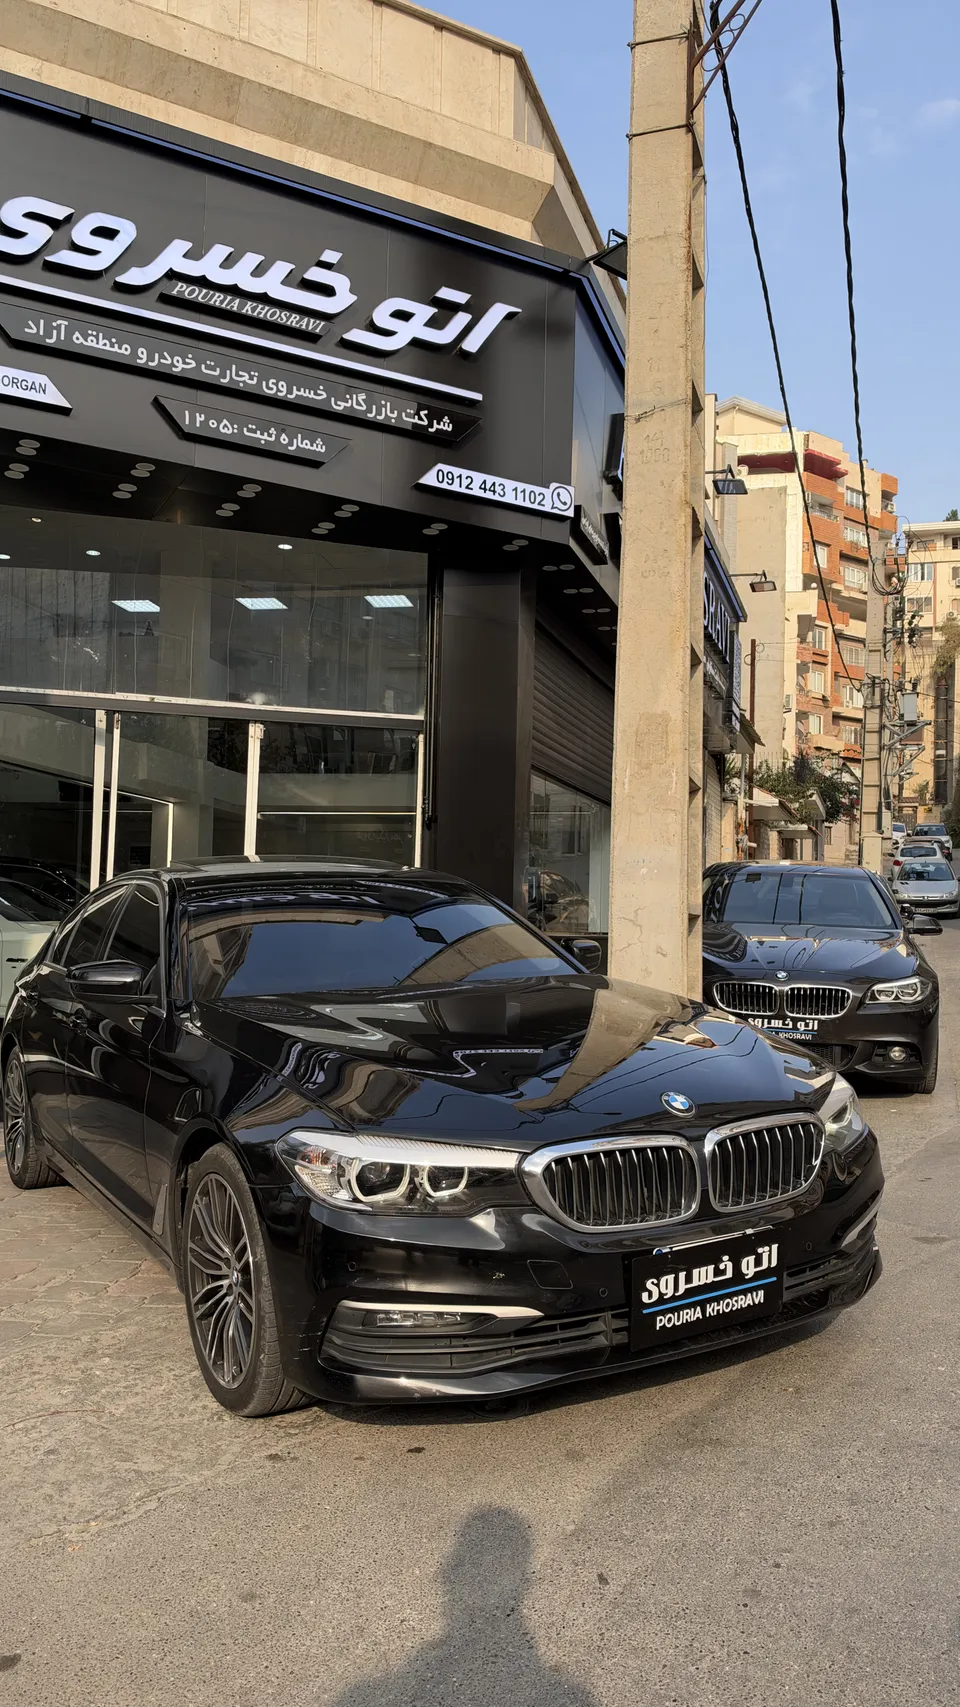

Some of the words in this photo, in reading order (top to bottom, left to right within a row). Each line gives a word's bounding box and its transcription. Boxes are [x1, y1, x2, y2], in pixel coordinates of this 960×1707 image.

[0, 196, 358, 315] خسروی
[171, 282, 238, 312] POURIA
[242, 302, 326, 334] KHOSRAVI
[342, 286, 522, 354] اتو
[24, 319, 69, 344] آزاد
[72, 329, 132, 356] منطقه
[136, 353, 197, 372] خودرو
[201, 360, 259, 387] تجارت
[262, 378, 327, 400] خسروی
[330, 393, 398, 424] بازرگانی
[402, 410, 453, 432] شرکت
[243, 423, 277, 444] ثبت
[280, 432, 326, 453] شماره
[436, 468, 474, 490] 0912
[478, 479, 506, 498] 443
[512, 486, 546, 507] 1102
[778, 1032, 812, 1041] KHOSRAVI
[796, 1020, 819, 1031] اتو
[741, 1243, 779, 1279] اتو
[641, 1255, 733, 1303] خسروی
[656, 1306, 702, 1330] POURIA
[706, 1289, 764, 1317] KHOSRAVI
